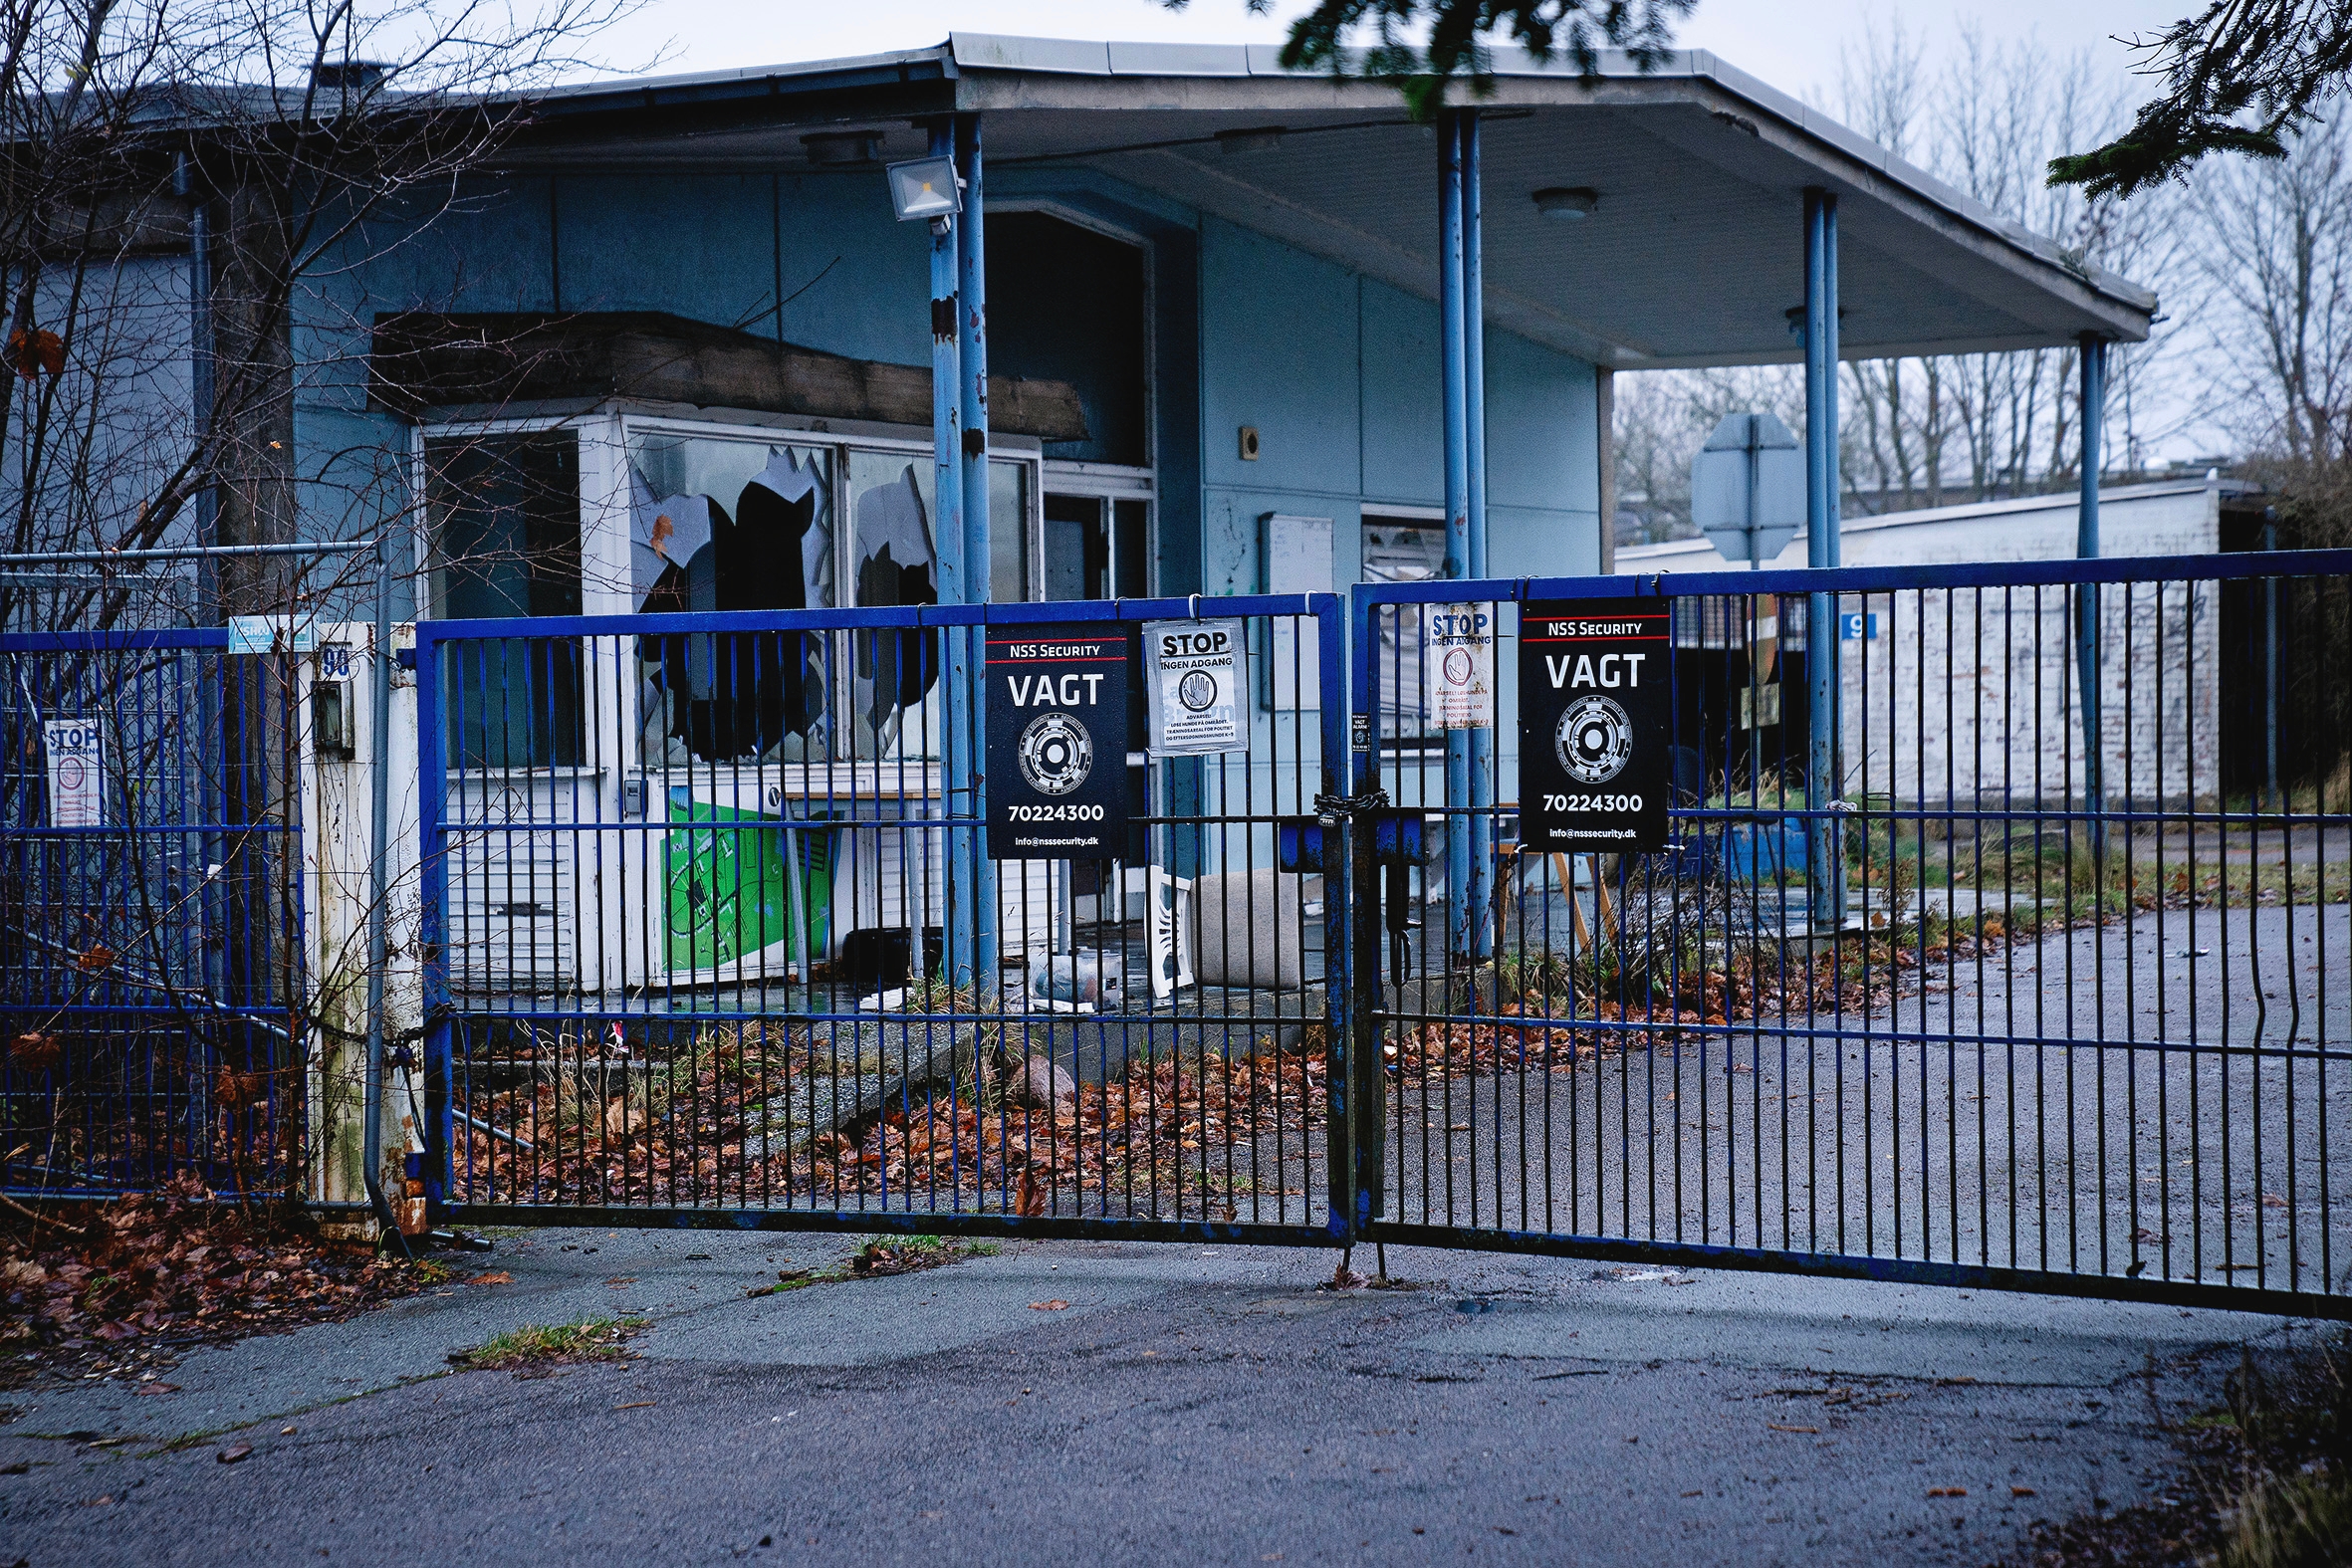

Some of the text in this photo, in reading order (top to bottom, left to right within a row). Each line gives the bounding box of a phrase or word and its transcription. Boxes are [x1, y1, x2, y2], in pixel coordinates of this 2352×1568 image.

[1433, 613, 1488, 636] STOP
[1548, 622, 1576, 636] NSS
[1010, 645, 1037, 658] NSS
[1162, 632, 1228, 655] STOP
[1160, 658, 1233, 670] INGEN ADGANG
[1545, 653, 1645, 689] VAGT
[1007, 673, 1104, 707] VAGT
[50, 728, 98, 748] STOP
[1543, 794, 1643, 811] 70224300
[1008, 804, 1104, 821] 70224300
[1015, 836, 1099, 847] info@nsssecurity.dk
[1549, 827, 1636, 839] info@nsssecurity.dk
